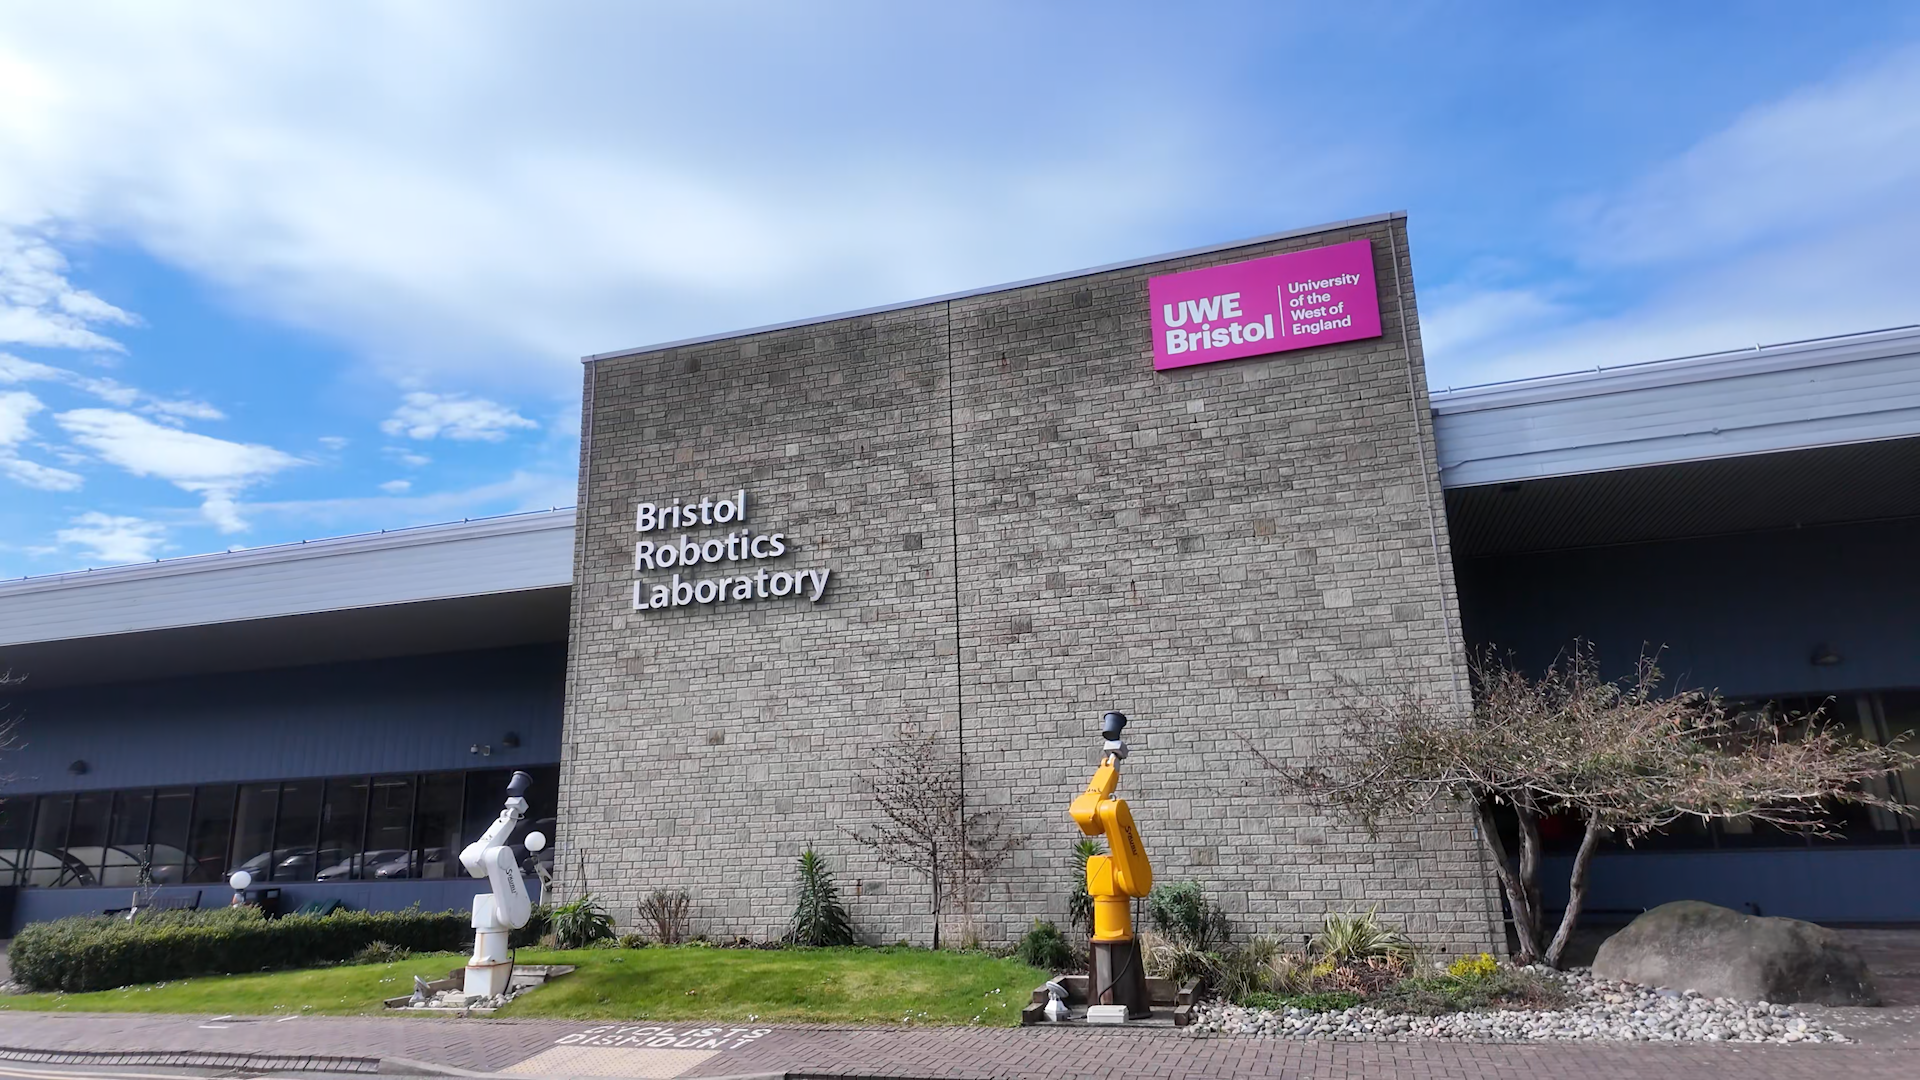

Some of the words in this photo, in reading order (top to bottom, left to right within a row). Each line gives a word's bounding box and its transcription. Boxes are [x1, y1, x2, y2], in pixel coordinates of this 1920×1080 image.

[1288, 273, 1360, 294] University
[1163, 292, 1243, 328] UWE
[1289, 295, 1305, 308] of
[1306, 291, 1332, 305] the
[1291, 307, 1328, 322] West
[1329, 302, 1344, 316] of
[1165, 314, 1275, 355] Bristol
[1292, 315, 1352, 336] England
[635, 489, 745, 532] Bristol
[634, 529, 785, 571] Robotics
[632, 568, 831, 610] Laboratory
[554, 1033, 755, 1049] DISMOUNT
[584, 1025, 772, 1039] CYCLISTS
